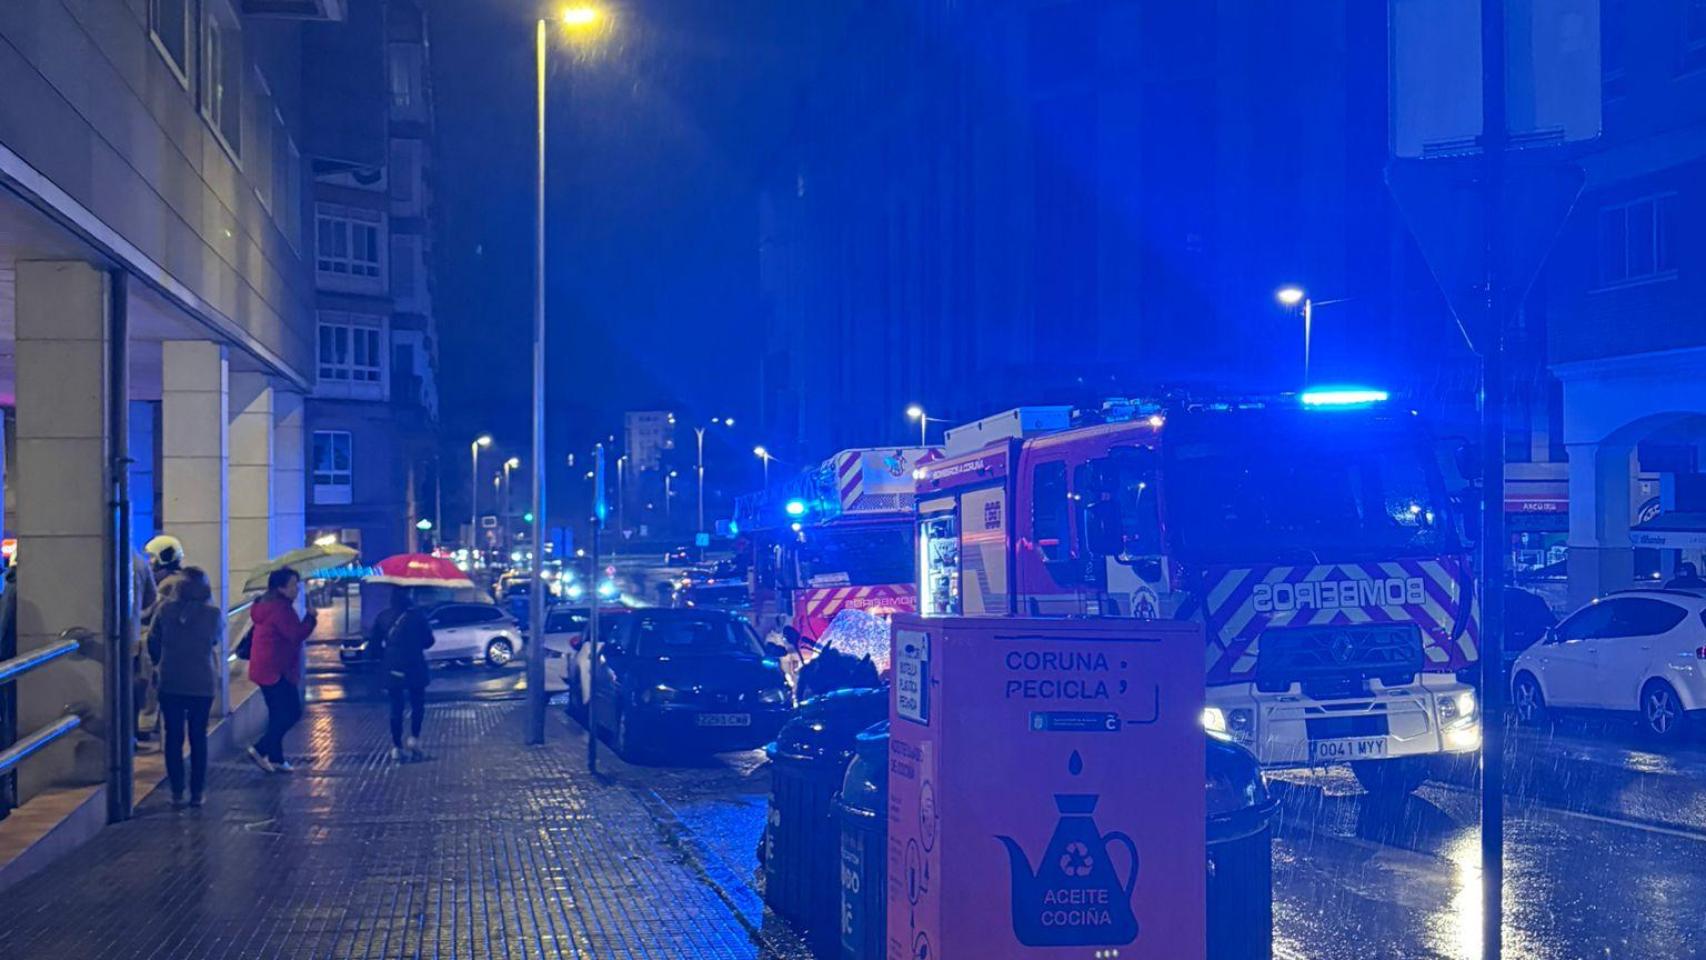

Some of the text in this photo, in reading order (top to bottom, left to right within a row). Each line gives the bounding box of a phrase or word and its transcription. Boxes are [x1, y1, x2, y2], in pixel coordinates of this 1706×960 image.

[1320, 740, 1384, 756] 0041 MYY
[1044, 889, 1109, 904] ACEITE
[1041, 907, 1112, 926] COCIÑA
